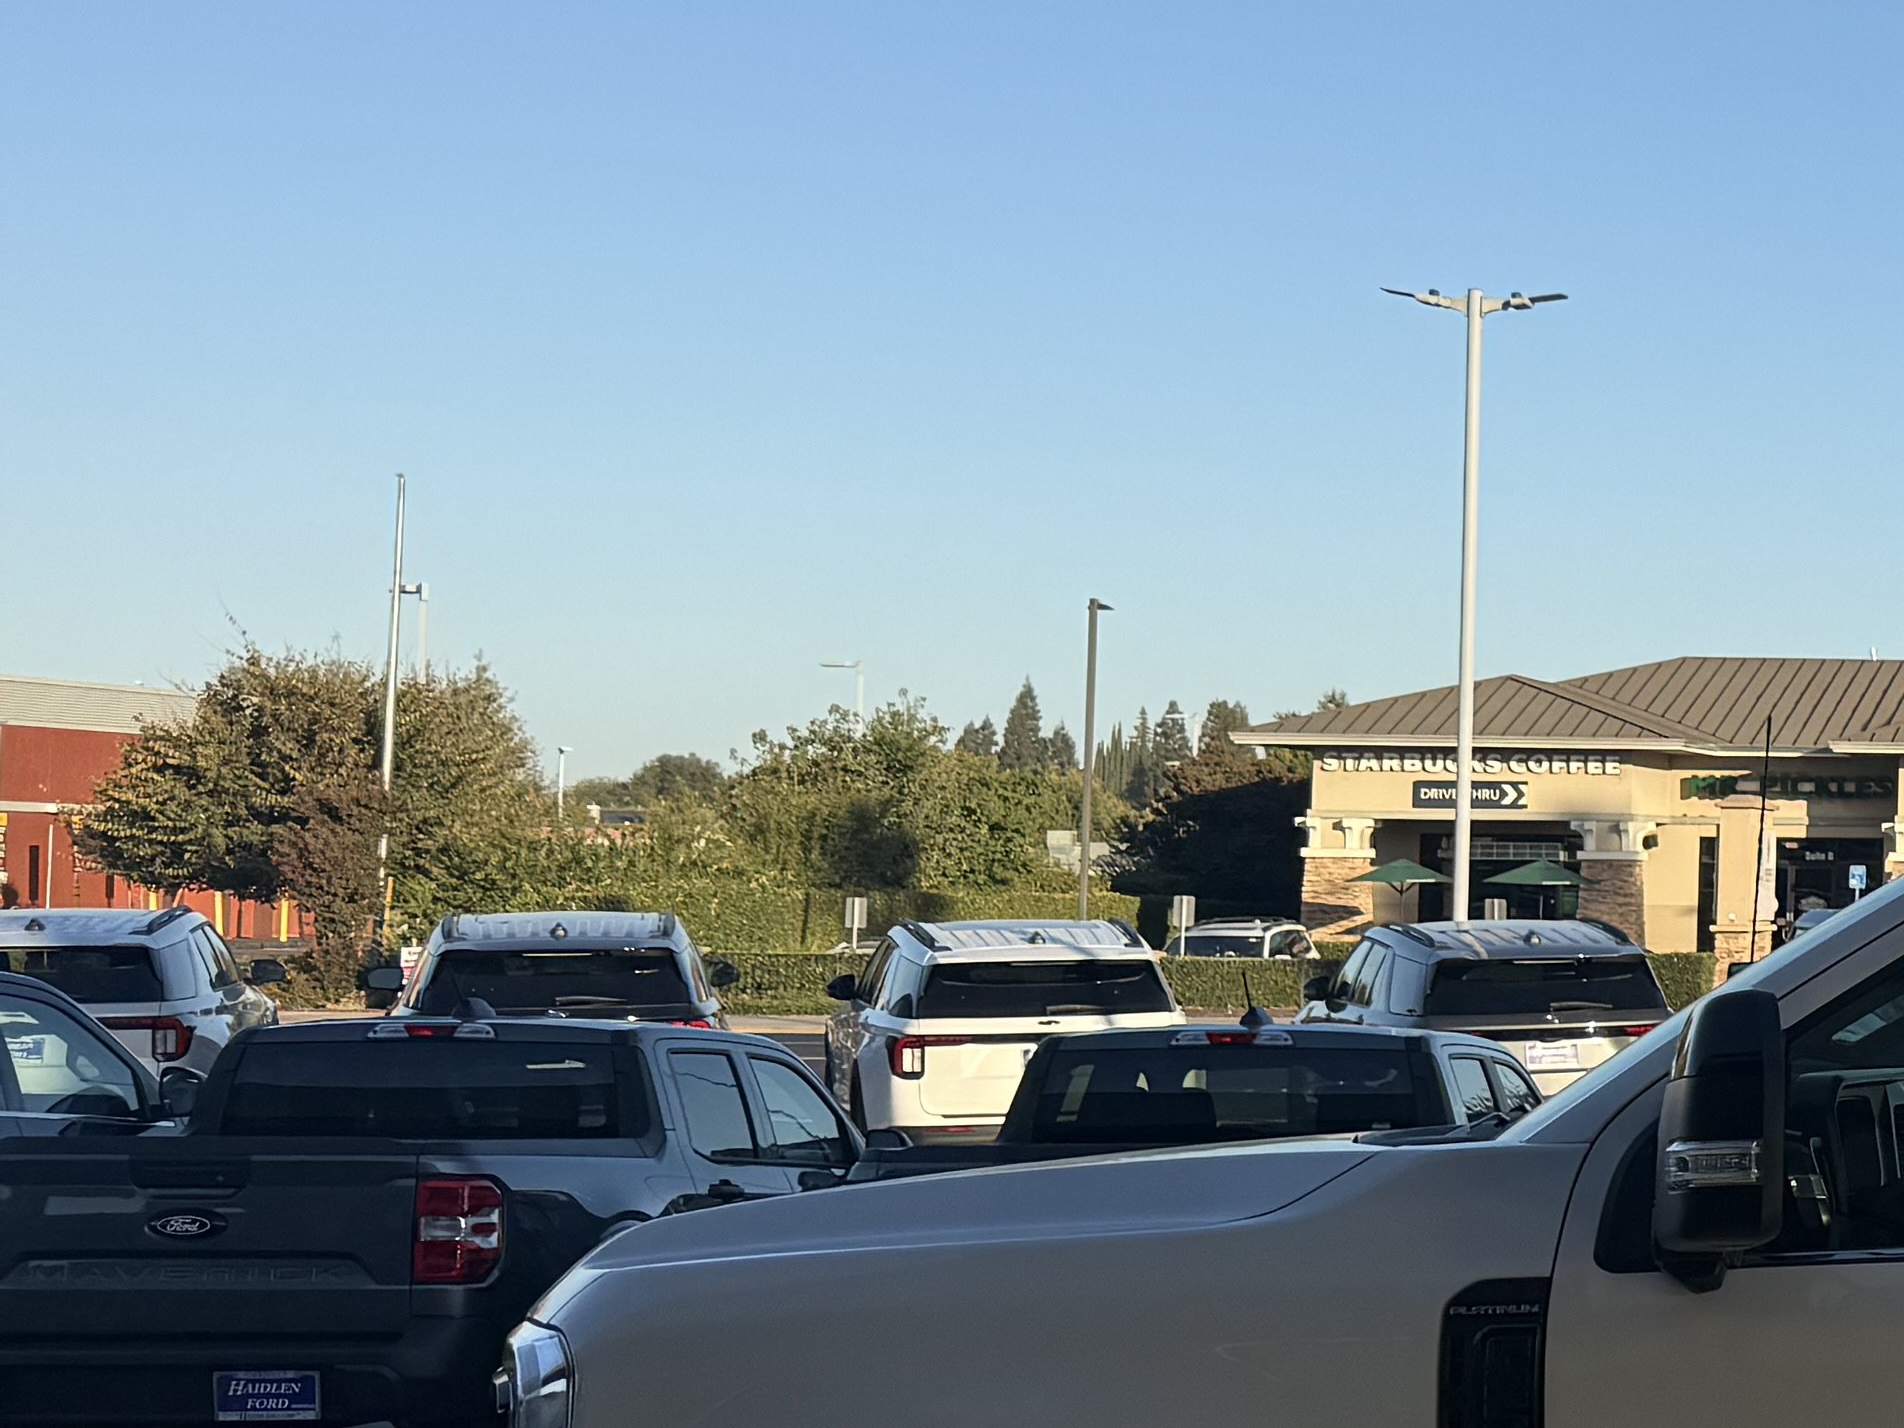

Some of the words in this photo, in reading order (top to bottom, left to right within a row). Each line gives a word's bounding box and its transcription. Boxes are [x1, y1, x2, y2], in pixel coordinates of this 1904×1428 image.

[1508, 753, 1621, 775] COFFEE
[1472, 788, 1500, 801] HRU
[166, 1217, 201, 1231] Ford
[227, 1379, 302, 1396] HAIDLEN
[246, 1398, 289, 1409] FORD
